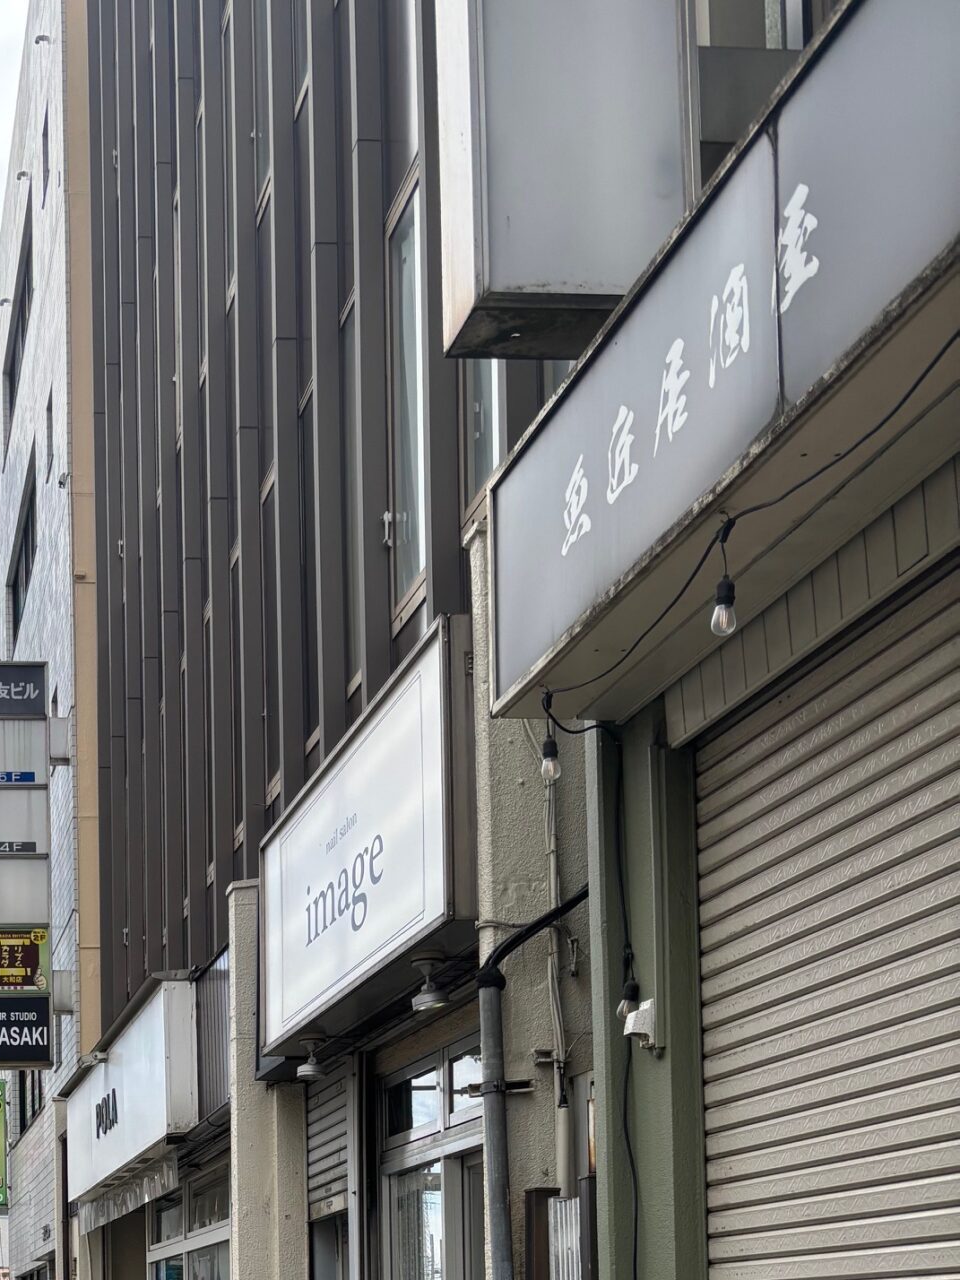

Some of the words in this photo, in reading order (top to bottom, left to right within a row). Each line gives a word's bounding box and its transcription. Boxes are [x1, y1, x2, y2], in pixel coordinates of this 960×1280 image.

[325, 828, 338, 855] nail
[339, 813, 358, 841] salon
[306, 833, 384, 948] image
[10, 1012, 38, 1021] STUDIO
[96, 1088, 118, 1139] POLA
